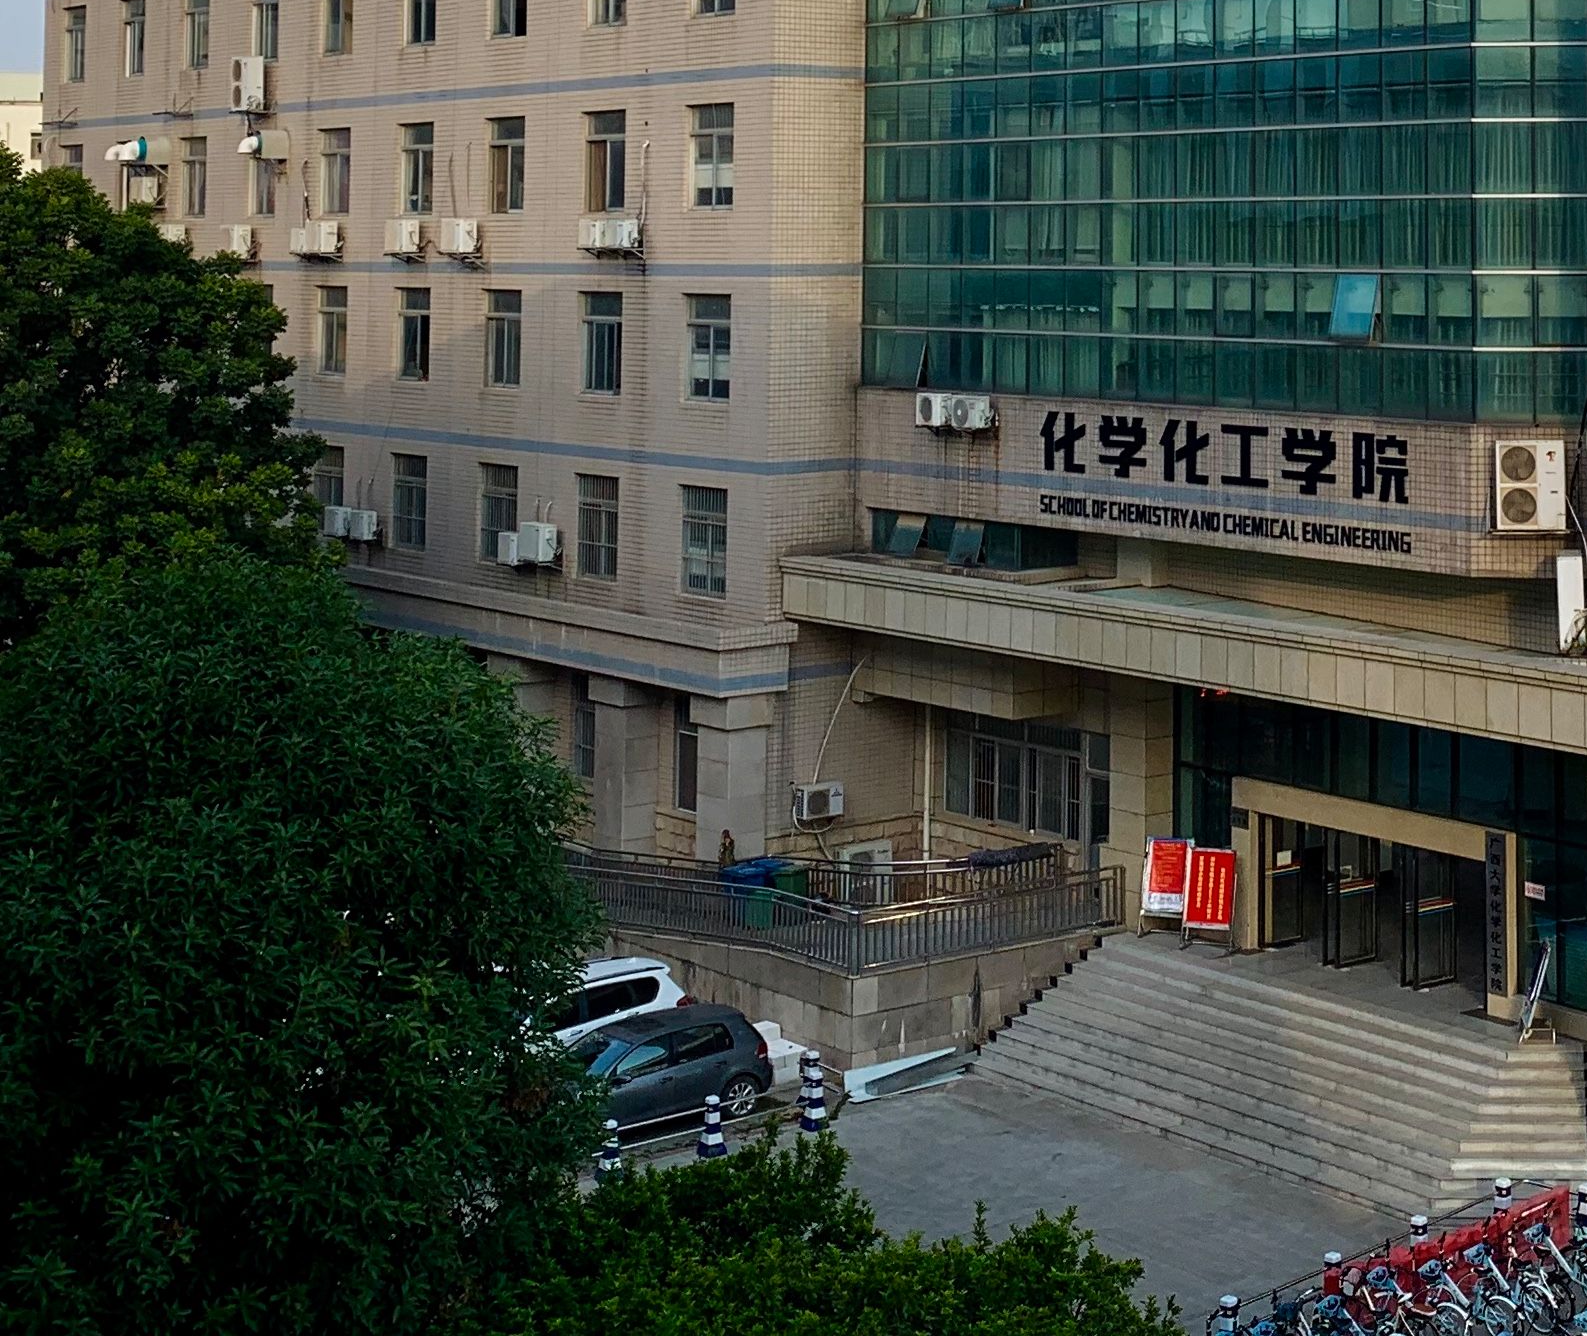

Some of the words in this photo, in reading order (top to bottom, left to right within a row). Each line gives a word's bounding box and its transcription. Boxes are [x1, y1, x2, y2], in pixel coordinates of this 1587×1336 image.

[1039, 410, 1409, 504] 化学化工学院
[1039, 494, 1092, 518] SCHOOL
[1091, 499, 1108, 520] OF
[1108, 501, 1190, 529] CHEMISTRY
[1189, 509, 1221, 533] AND
[1222, 513, 1299, 542] CHEMICAL
[1301, 521, 1412, 554] ENGINEERING
